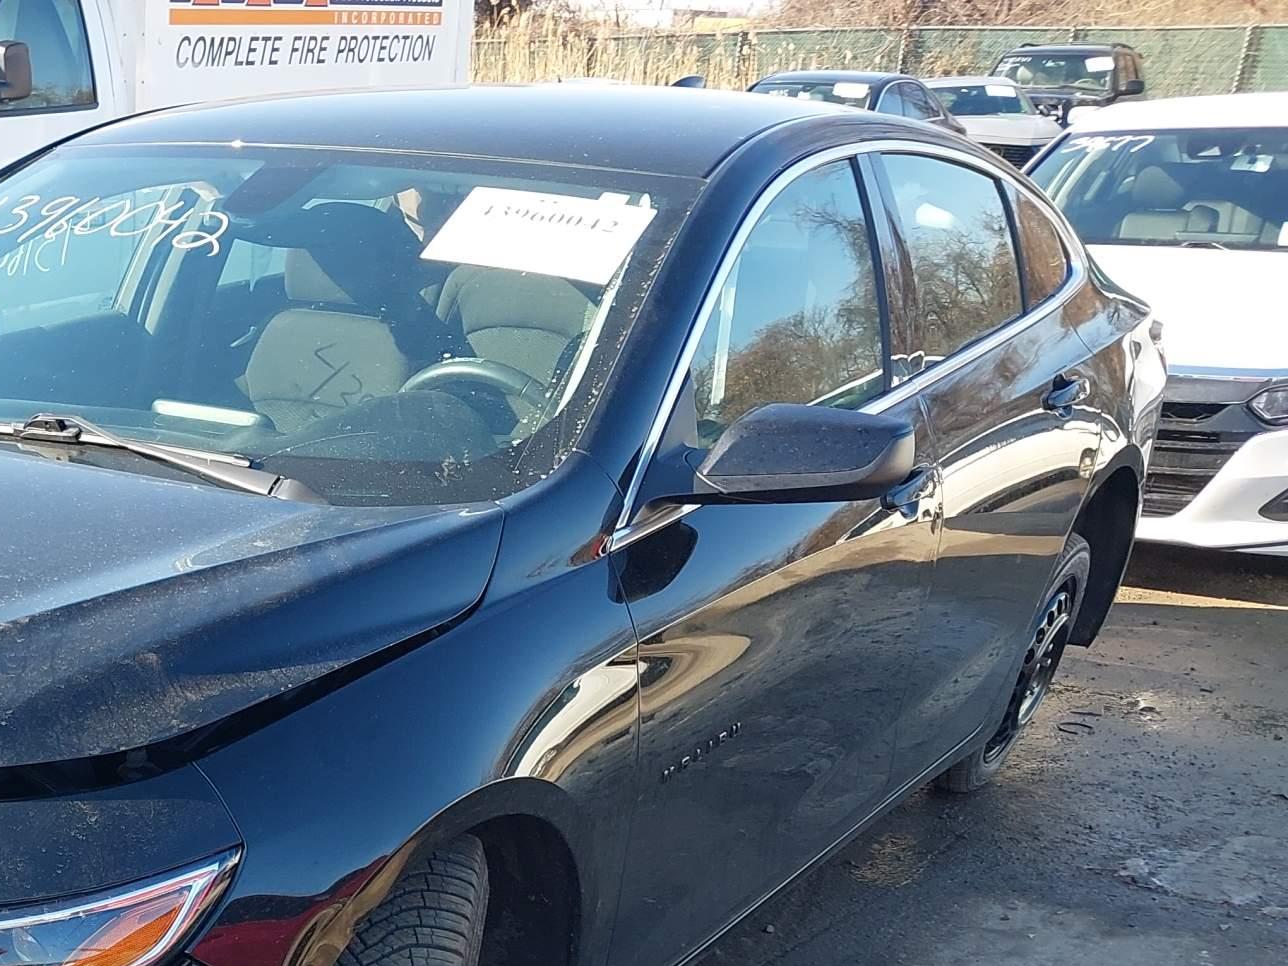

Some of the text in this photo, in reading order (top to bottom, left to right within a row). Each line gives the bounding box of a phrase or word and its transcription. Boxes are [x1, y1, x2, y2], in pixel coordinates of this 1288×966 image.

[334, 12, 440, 25] INCORPORATED
[175, 34, 437, 68] COMPLETE FIRE PROTECTION
